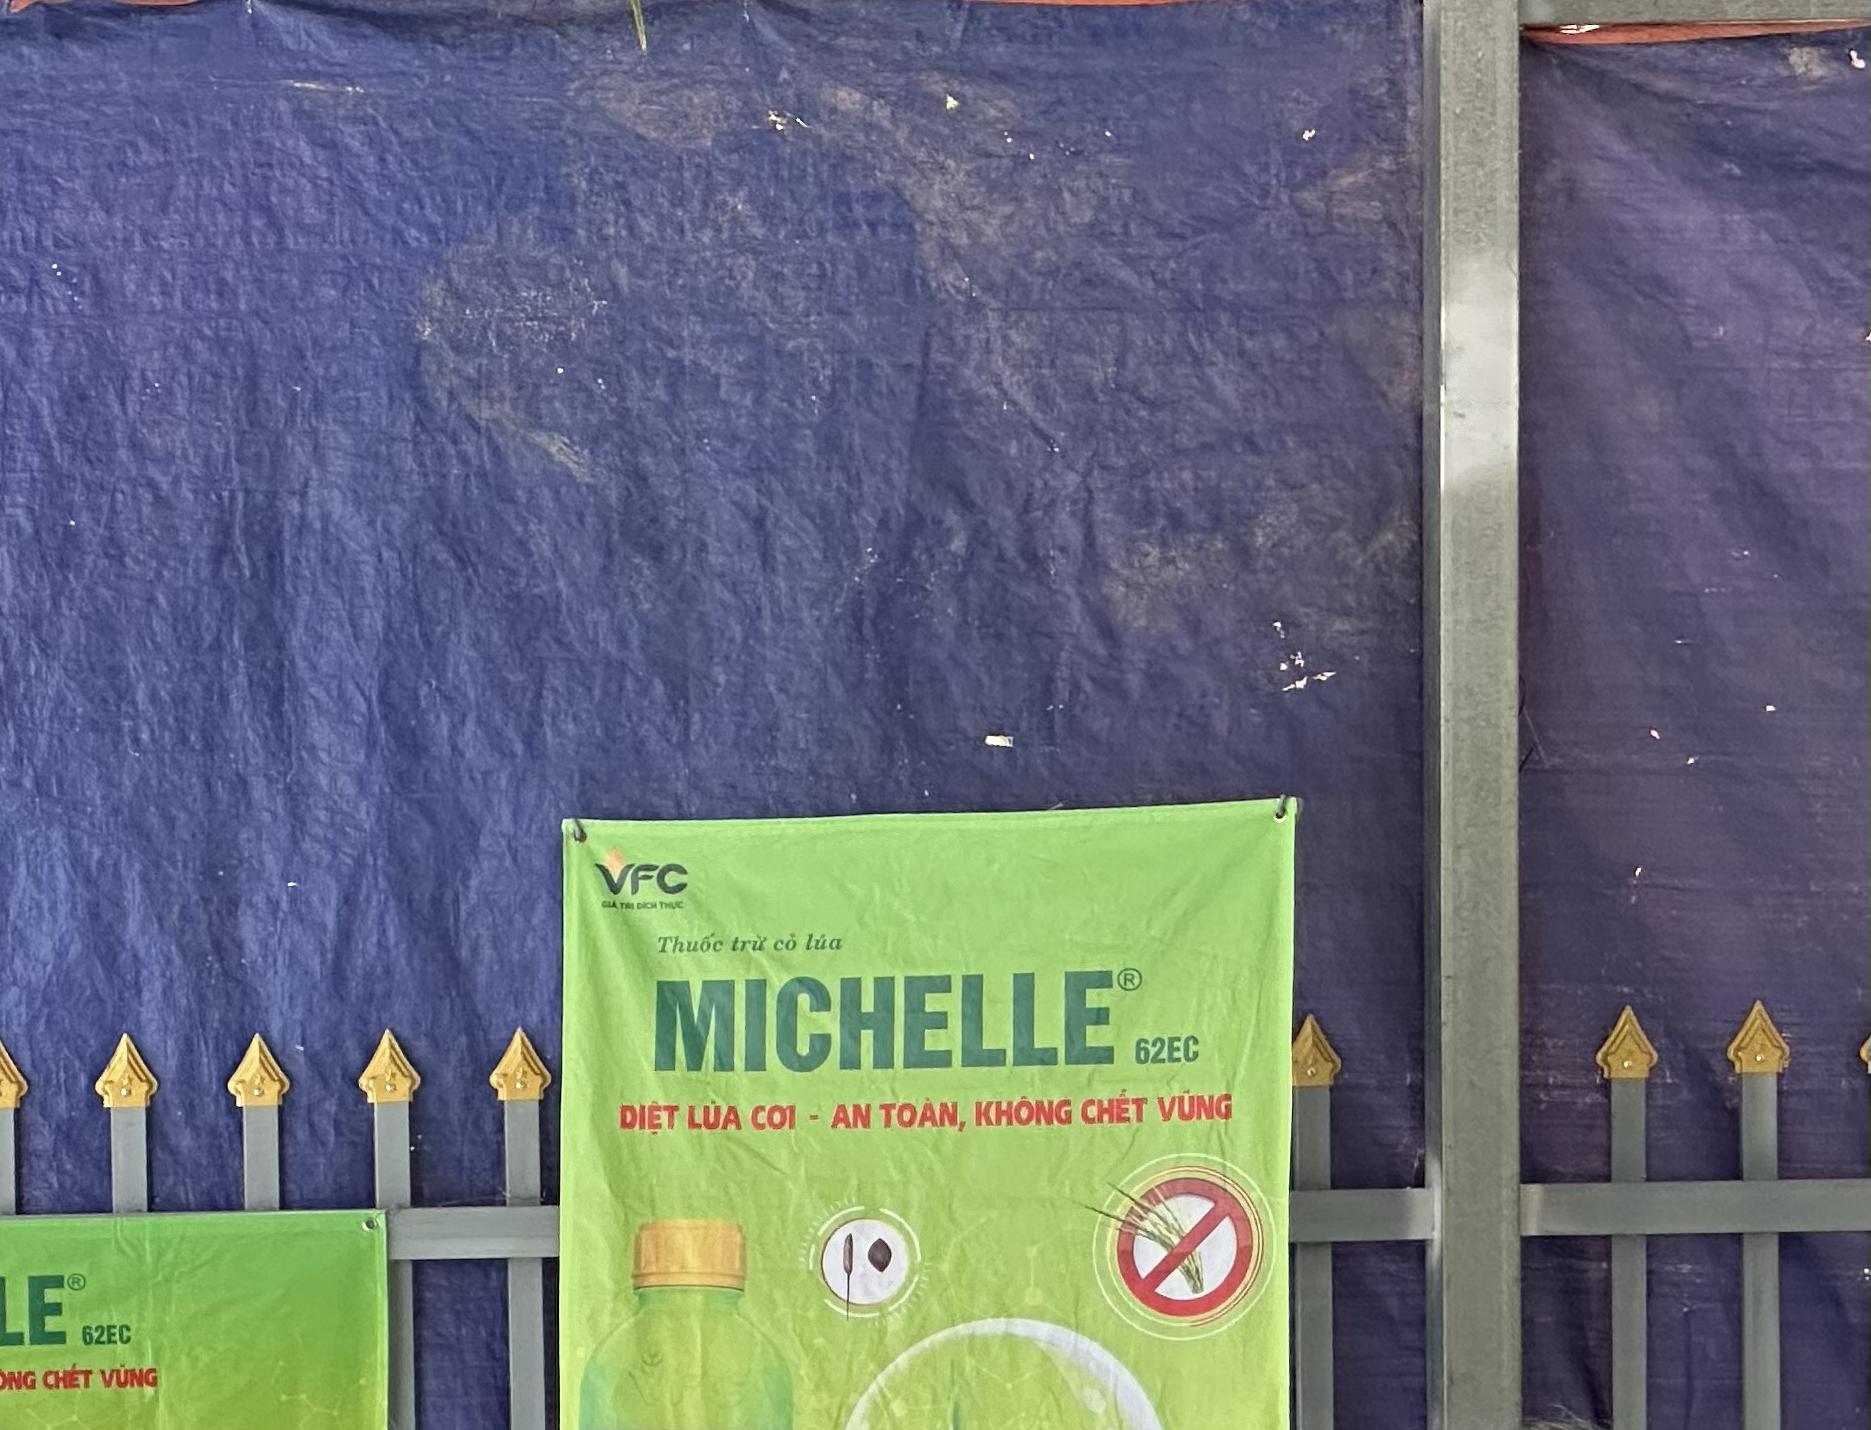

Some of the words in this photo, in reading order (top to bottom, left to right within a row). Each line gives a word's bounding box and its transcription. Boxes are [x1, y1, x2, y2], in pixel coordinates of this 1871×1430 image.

[594, 863, 688, 895] VFC
[657, 932, 724, 954] Thuốc
[732, 934, 767, 952] trừ
[805, 932, 843, 951] lúa
[1134, 1035, 1201, 1065] 62EC
[831, 1104, 871, 1130] AN
[975, 1095, 1073, 1126] KHÔNG
[82, 1324, 132, 1346] 62EC
